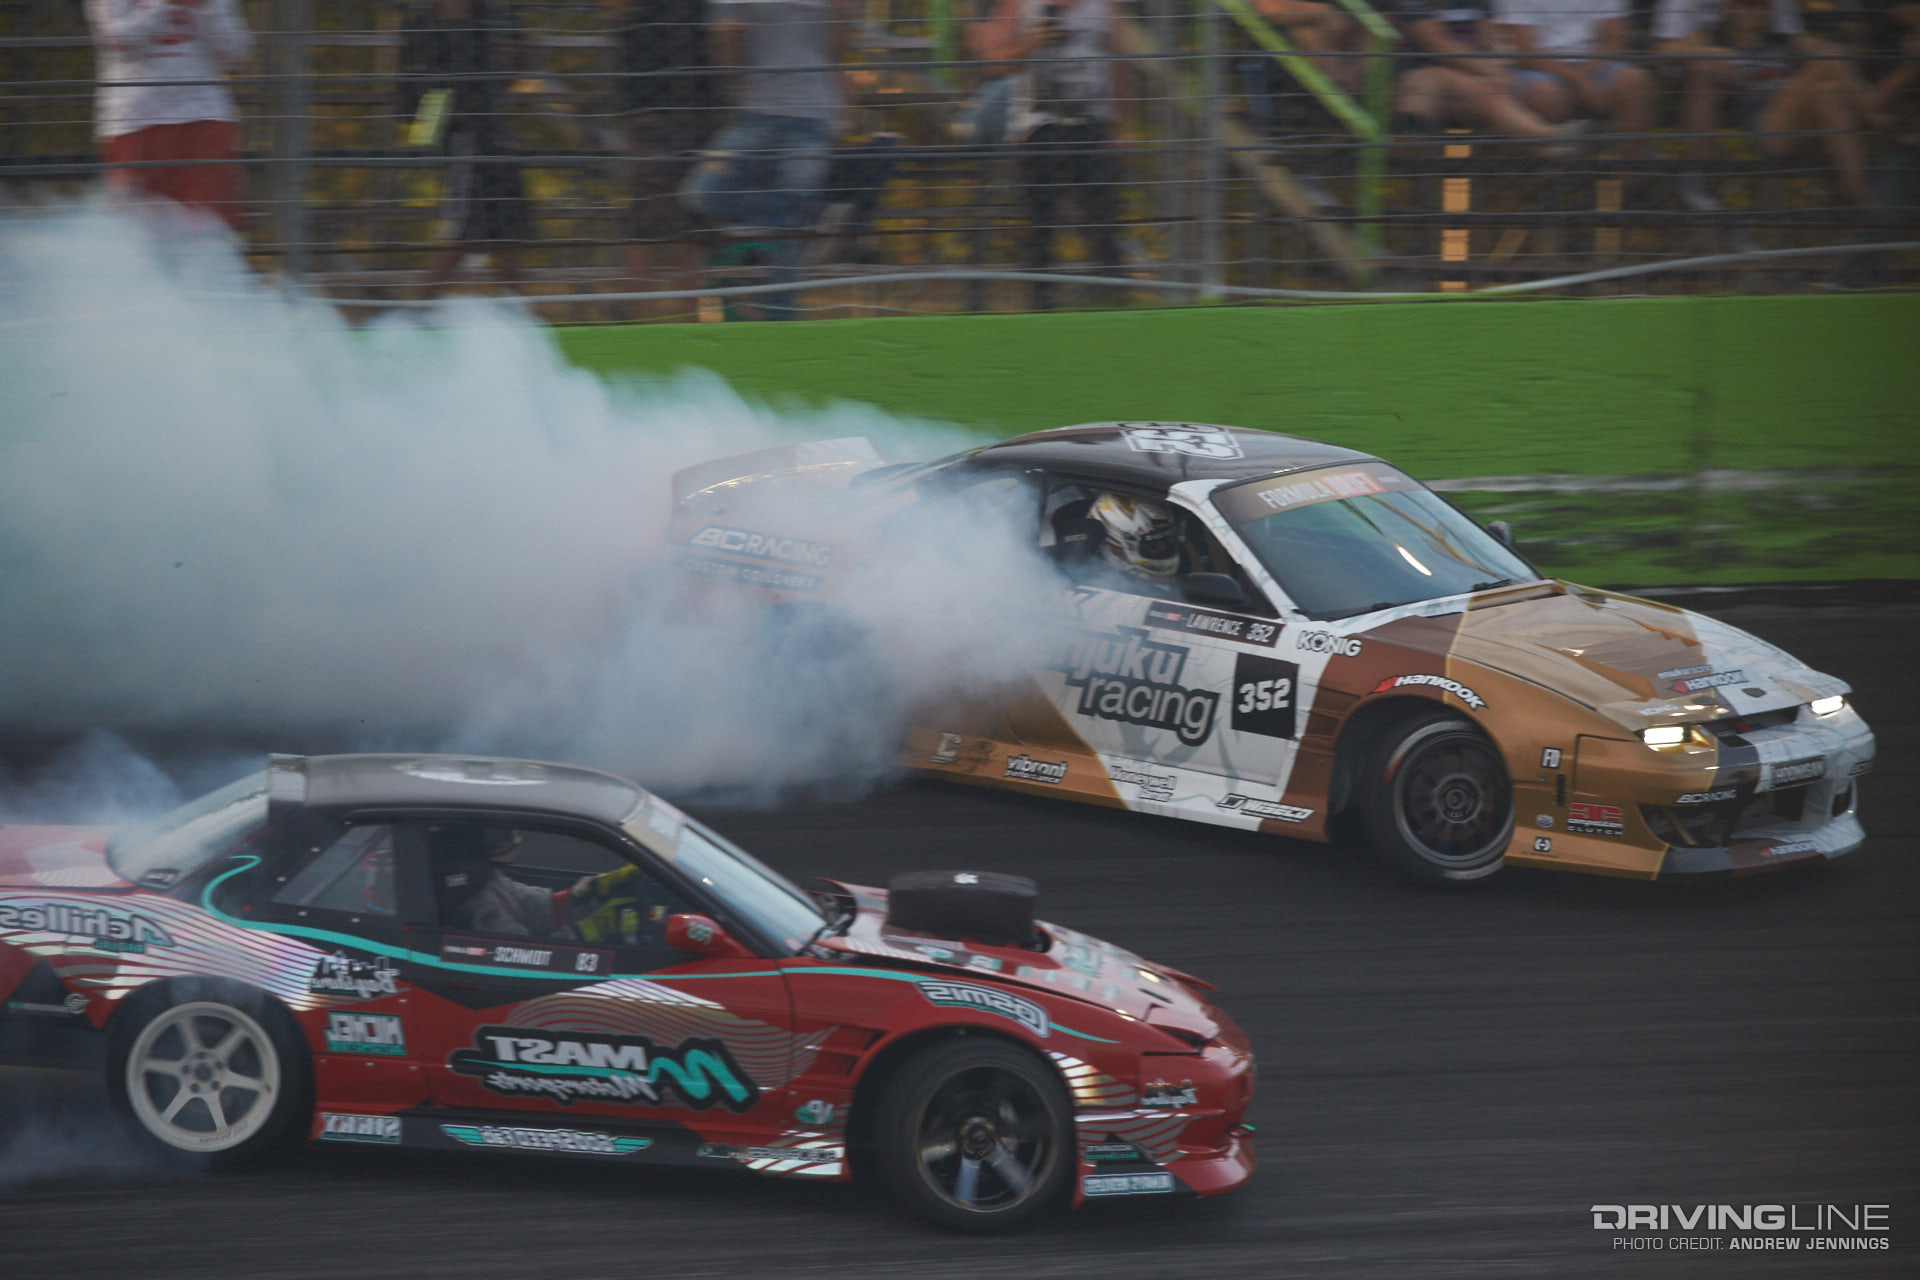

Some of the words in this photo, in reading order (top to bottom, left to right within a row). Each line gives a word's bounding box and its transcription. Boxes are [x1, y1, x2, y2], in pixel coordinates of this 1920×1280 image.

[1257, 481, 1334, 509] FORMULA
[1185, 612, 1246, 636] LAWRENCE
[1246, 624, 1276, 643] 352
[1085, 677, 1213, 740] racing
[1237, 677, 1291, 714] 352
[1006, 755, 1068, 778] vibrant
[1109, 766, 1177, 790] Honeywell
[493, 946, 553, 967] SCHMIDT
[575, 952, 599, 972] 83
